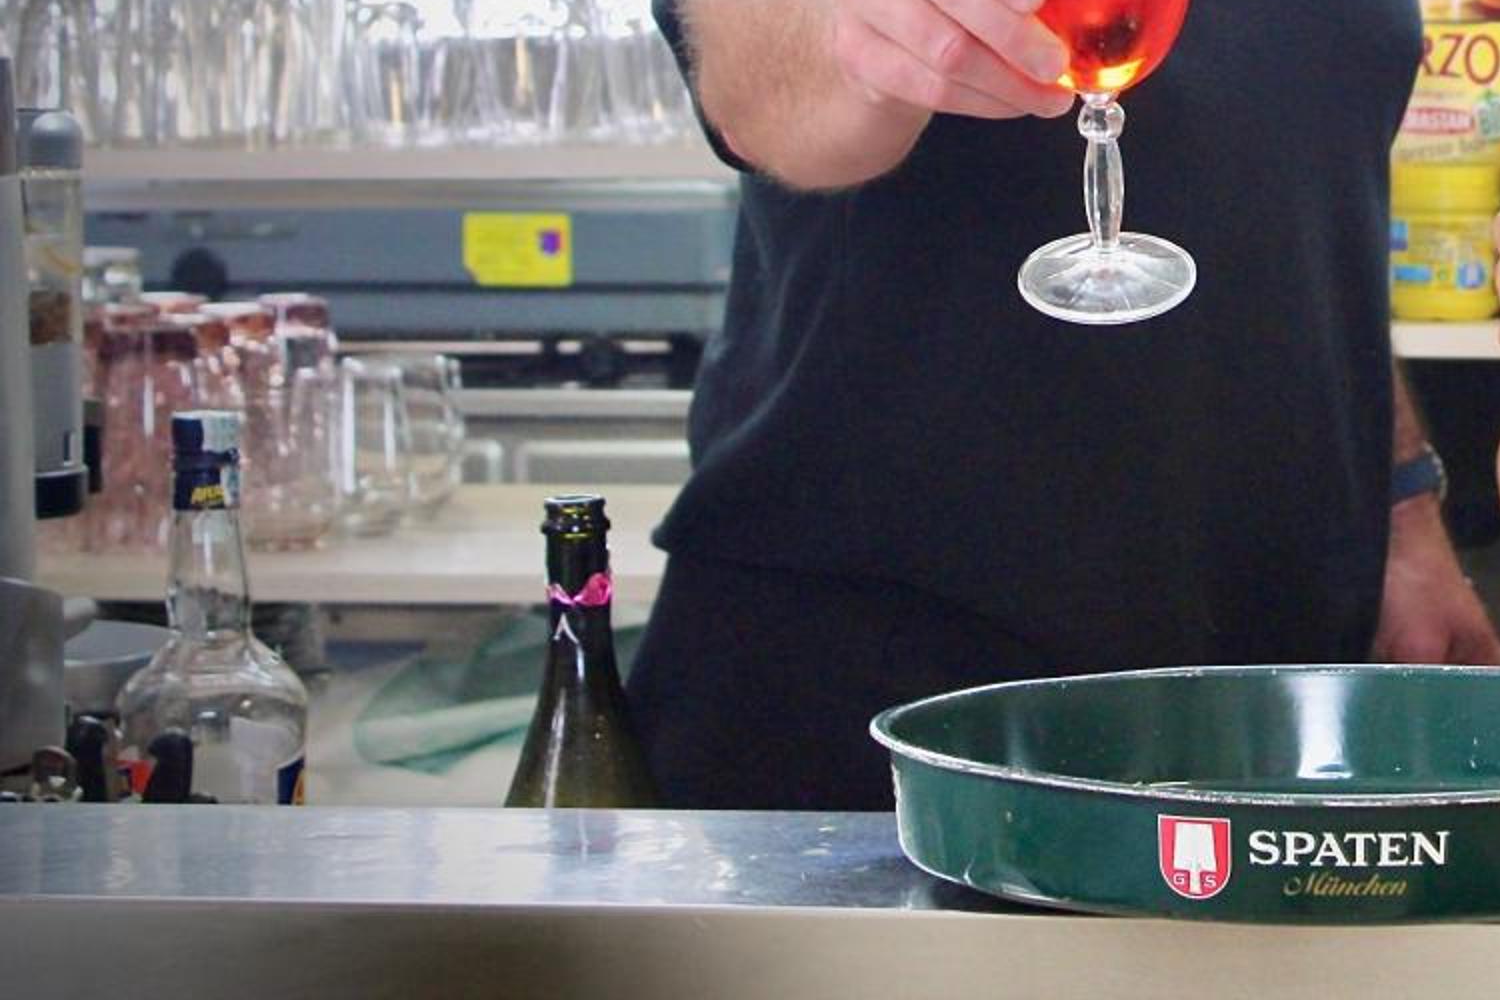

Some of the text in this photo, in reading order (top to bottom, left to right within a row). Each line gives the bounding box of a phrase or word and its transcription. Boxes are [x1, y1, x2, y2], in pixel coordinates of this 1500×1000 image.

[1420, 34, 1500, 84] RZO
[1248, 830, 1449, 867] SPATEN
[1172, 874, 1217, 889] G S
[1283, 871, 1407, 897] München
